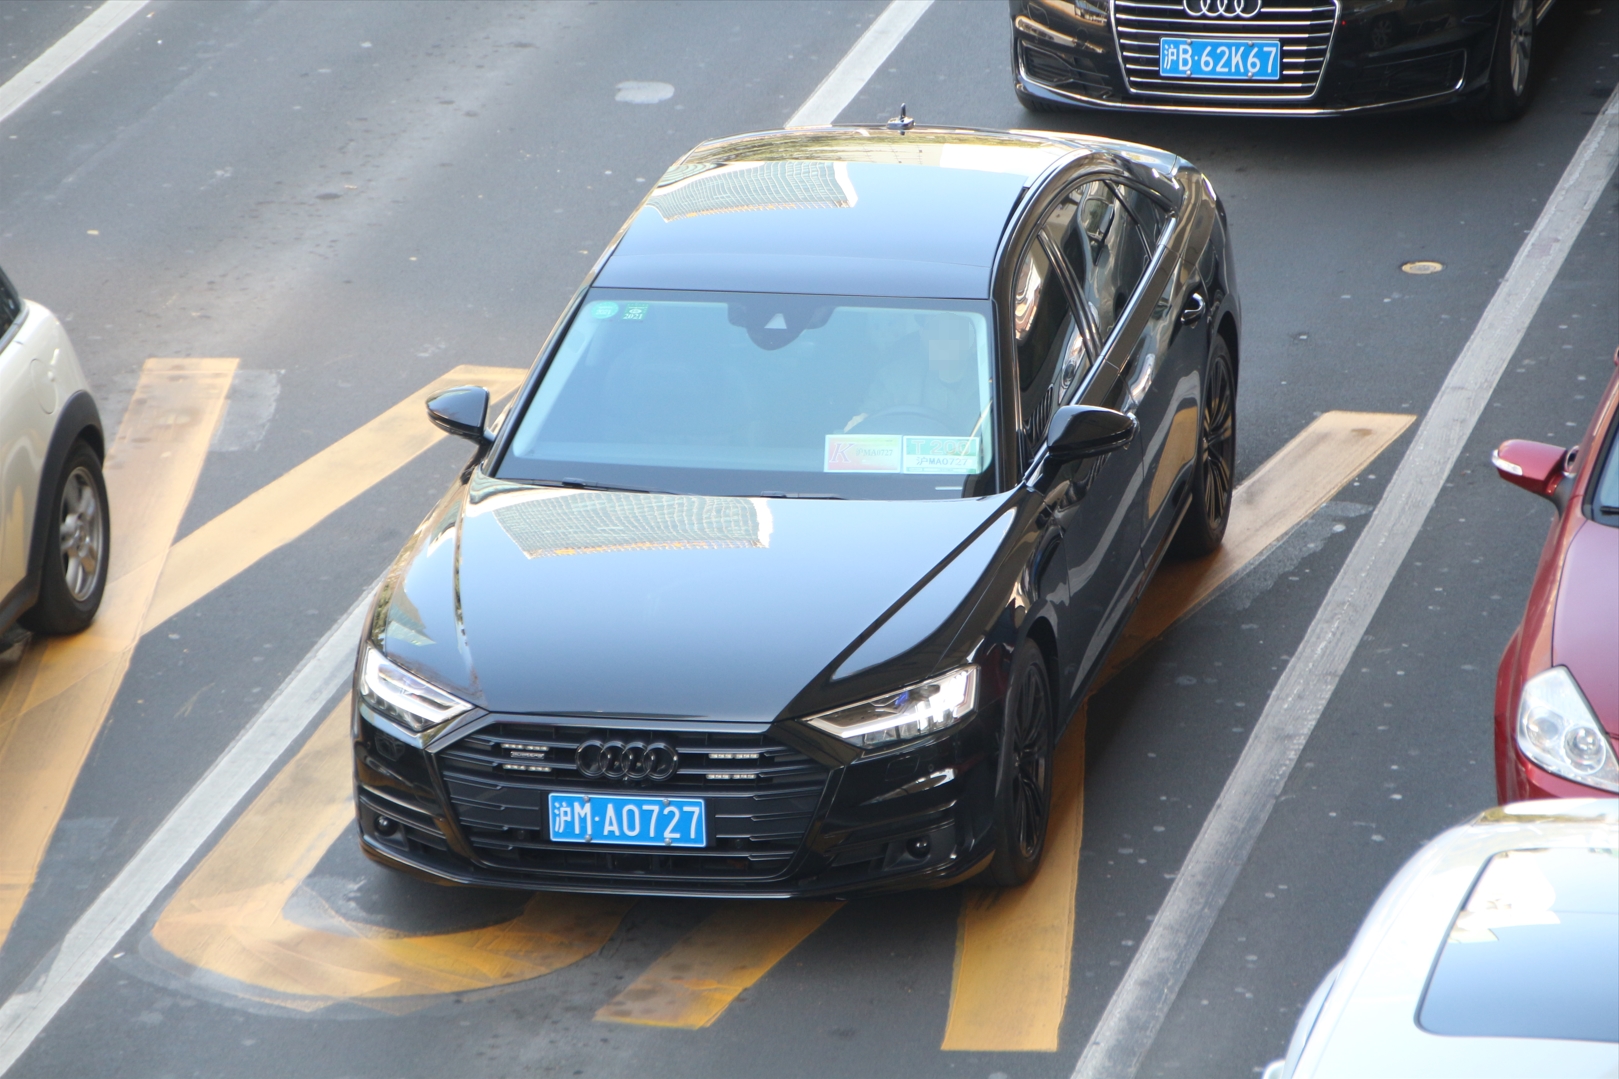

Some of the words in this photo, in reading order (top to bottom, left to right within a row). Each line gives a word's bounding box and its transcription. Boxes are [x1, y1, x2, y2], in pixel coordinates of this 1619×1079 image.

[1163, 44, 1277, 73] 沪B·62K67
[829, 442, 857, 463] K
[554, 802, 700, 839] 沪M·A0727
